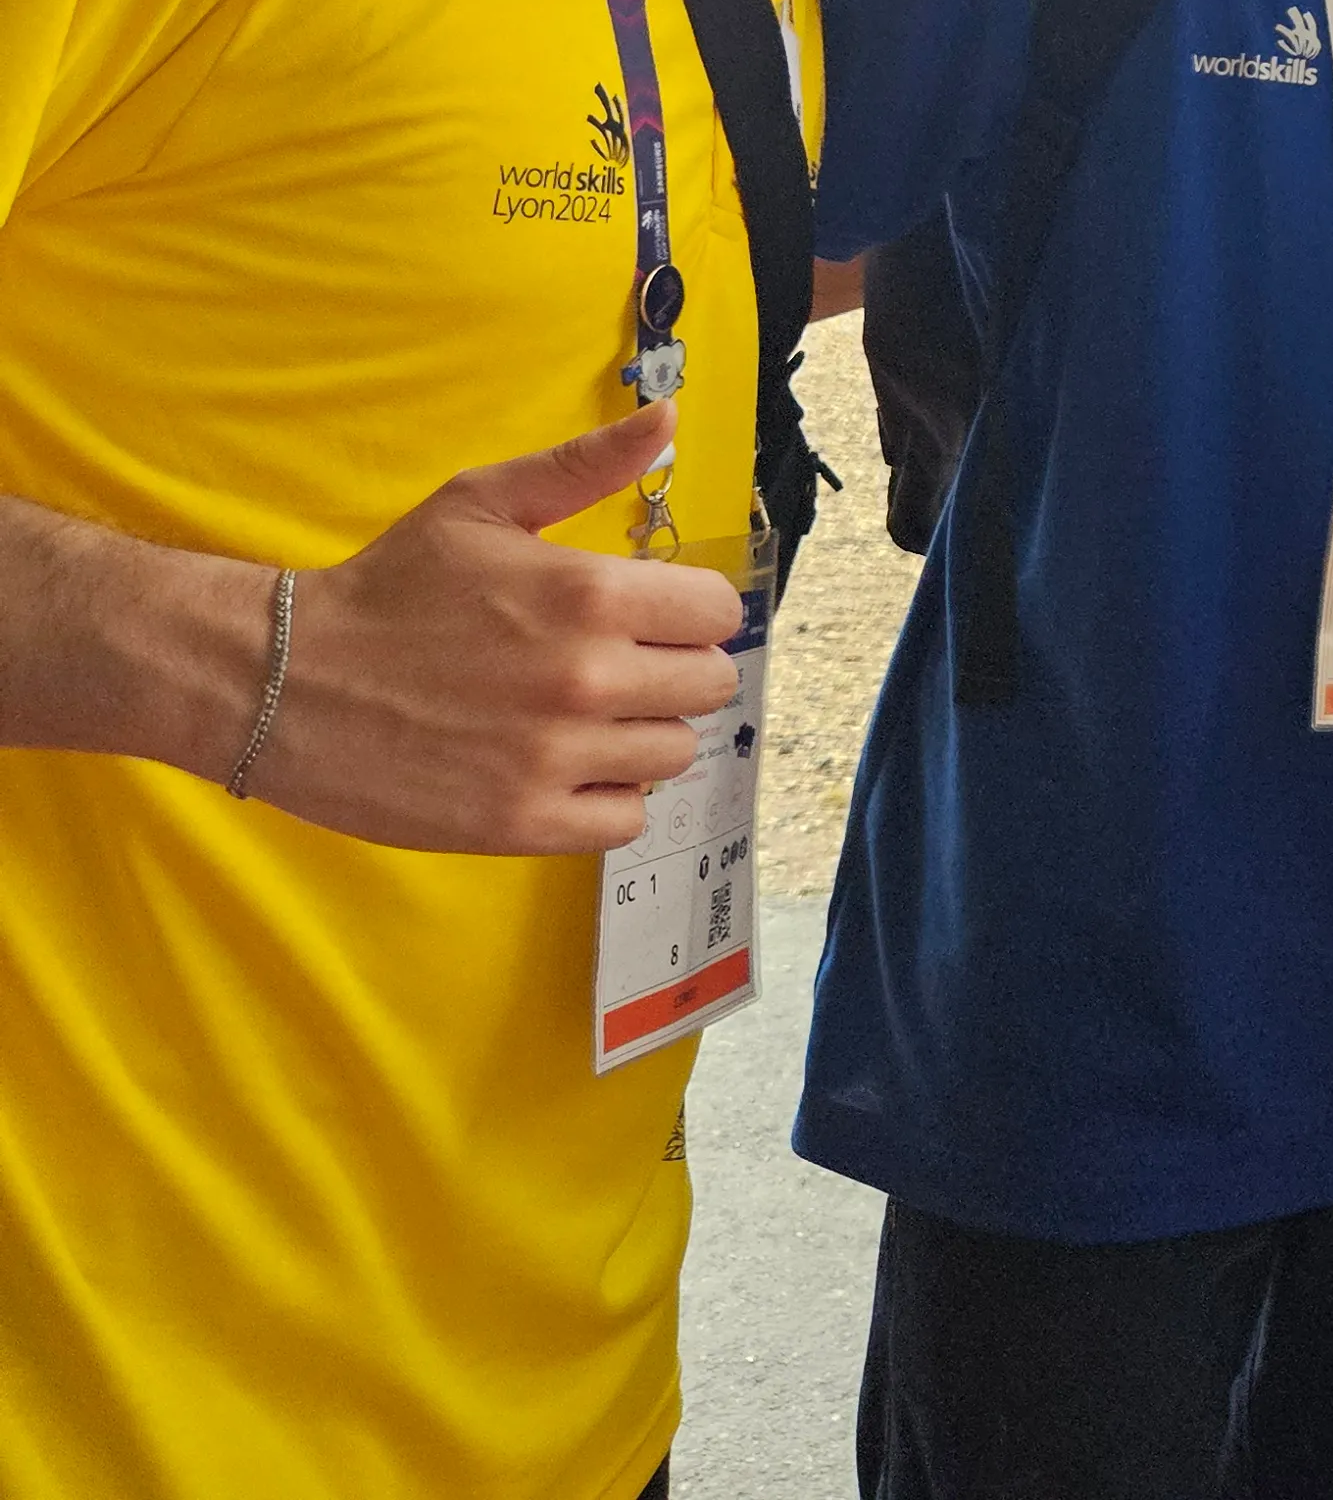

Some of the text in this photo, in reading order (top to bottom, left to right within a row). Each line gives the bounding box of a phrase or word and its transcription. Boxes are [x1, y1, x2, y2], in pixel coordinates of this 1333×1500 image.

[1193, 51, 1318, 87] worldskills
[492, 188, 612, 225] Lyon2024
[650, 873, 657, 895] 1
[670, 944, 679, 966] 8
